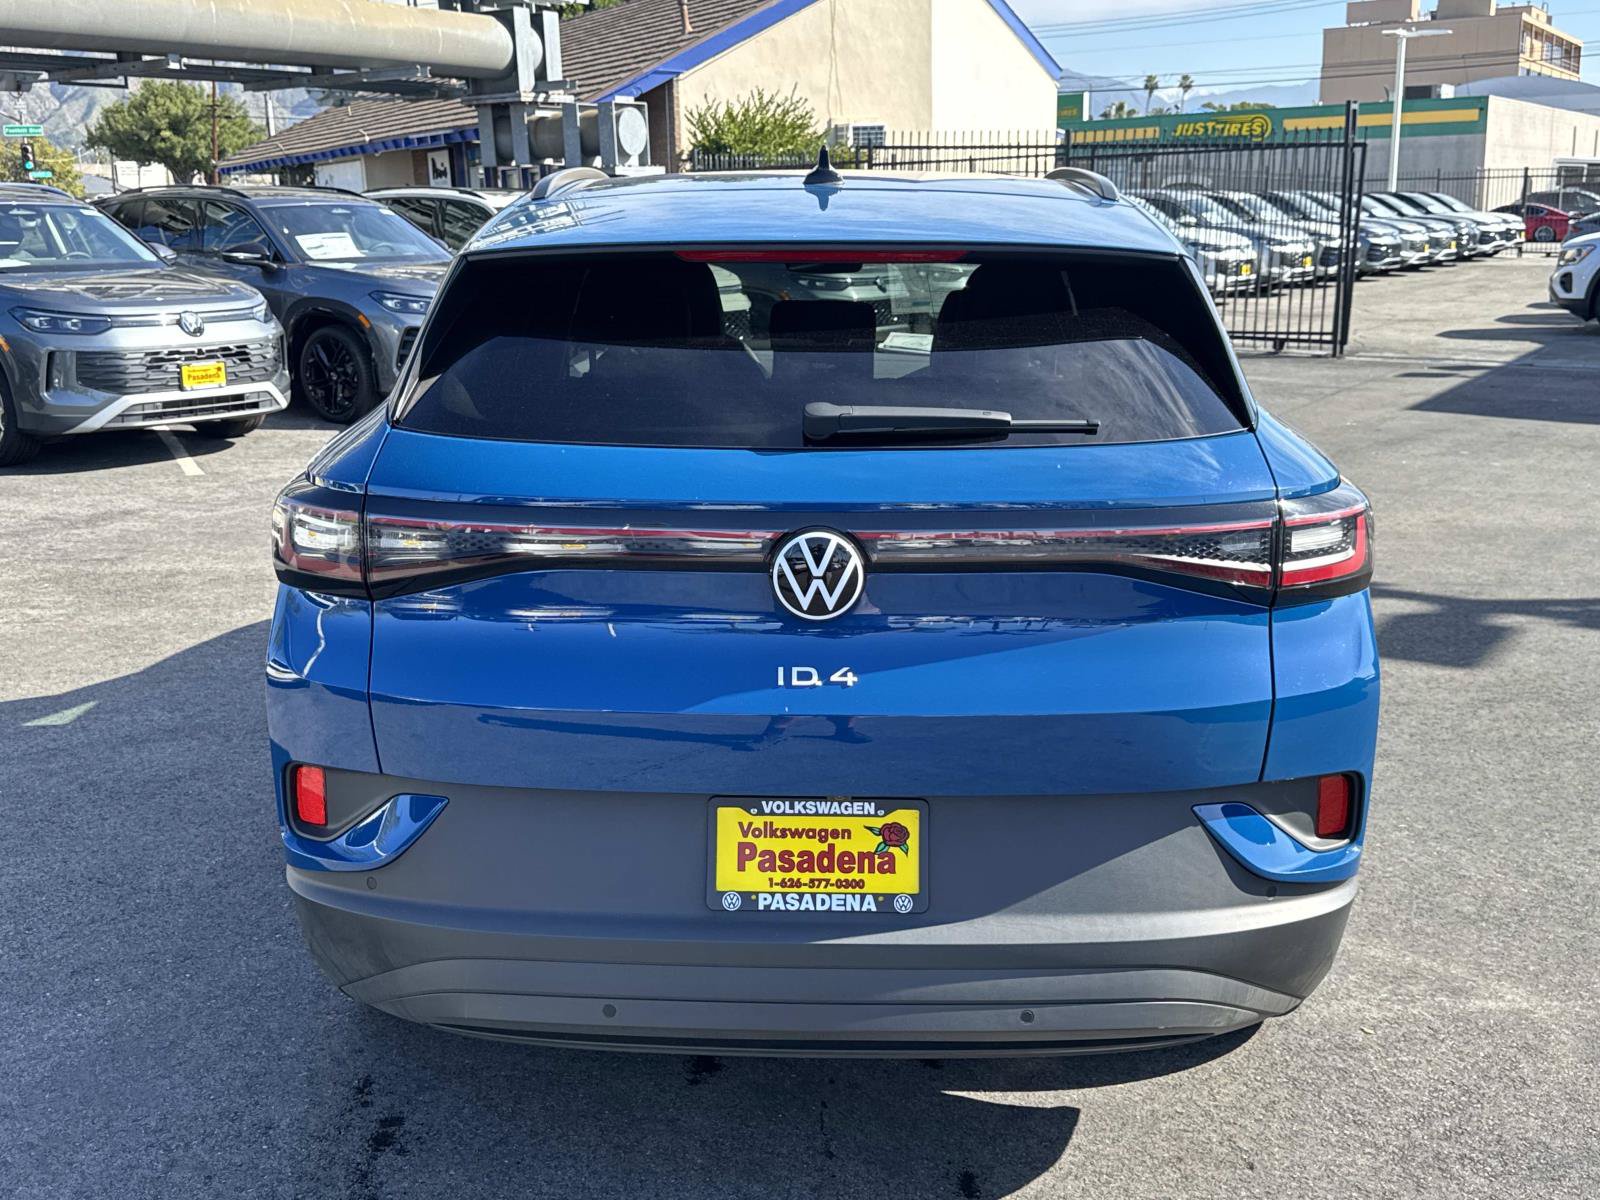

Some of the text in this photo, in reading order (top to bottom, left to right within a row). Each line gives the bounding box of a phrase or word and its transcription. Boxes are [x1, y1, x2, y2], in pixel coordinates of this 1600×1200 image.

[1171, 122, 1216, 137] JUST
[762, 800, 875, 815] VOLKSWAGEN
[737, 821, 852, 843] Volkswagen
[736, 841, 896, 874] Pasadena
[768, 877, 865, 889] 1-626-577-0300
[758, 893, 877, 911] PASADENA
